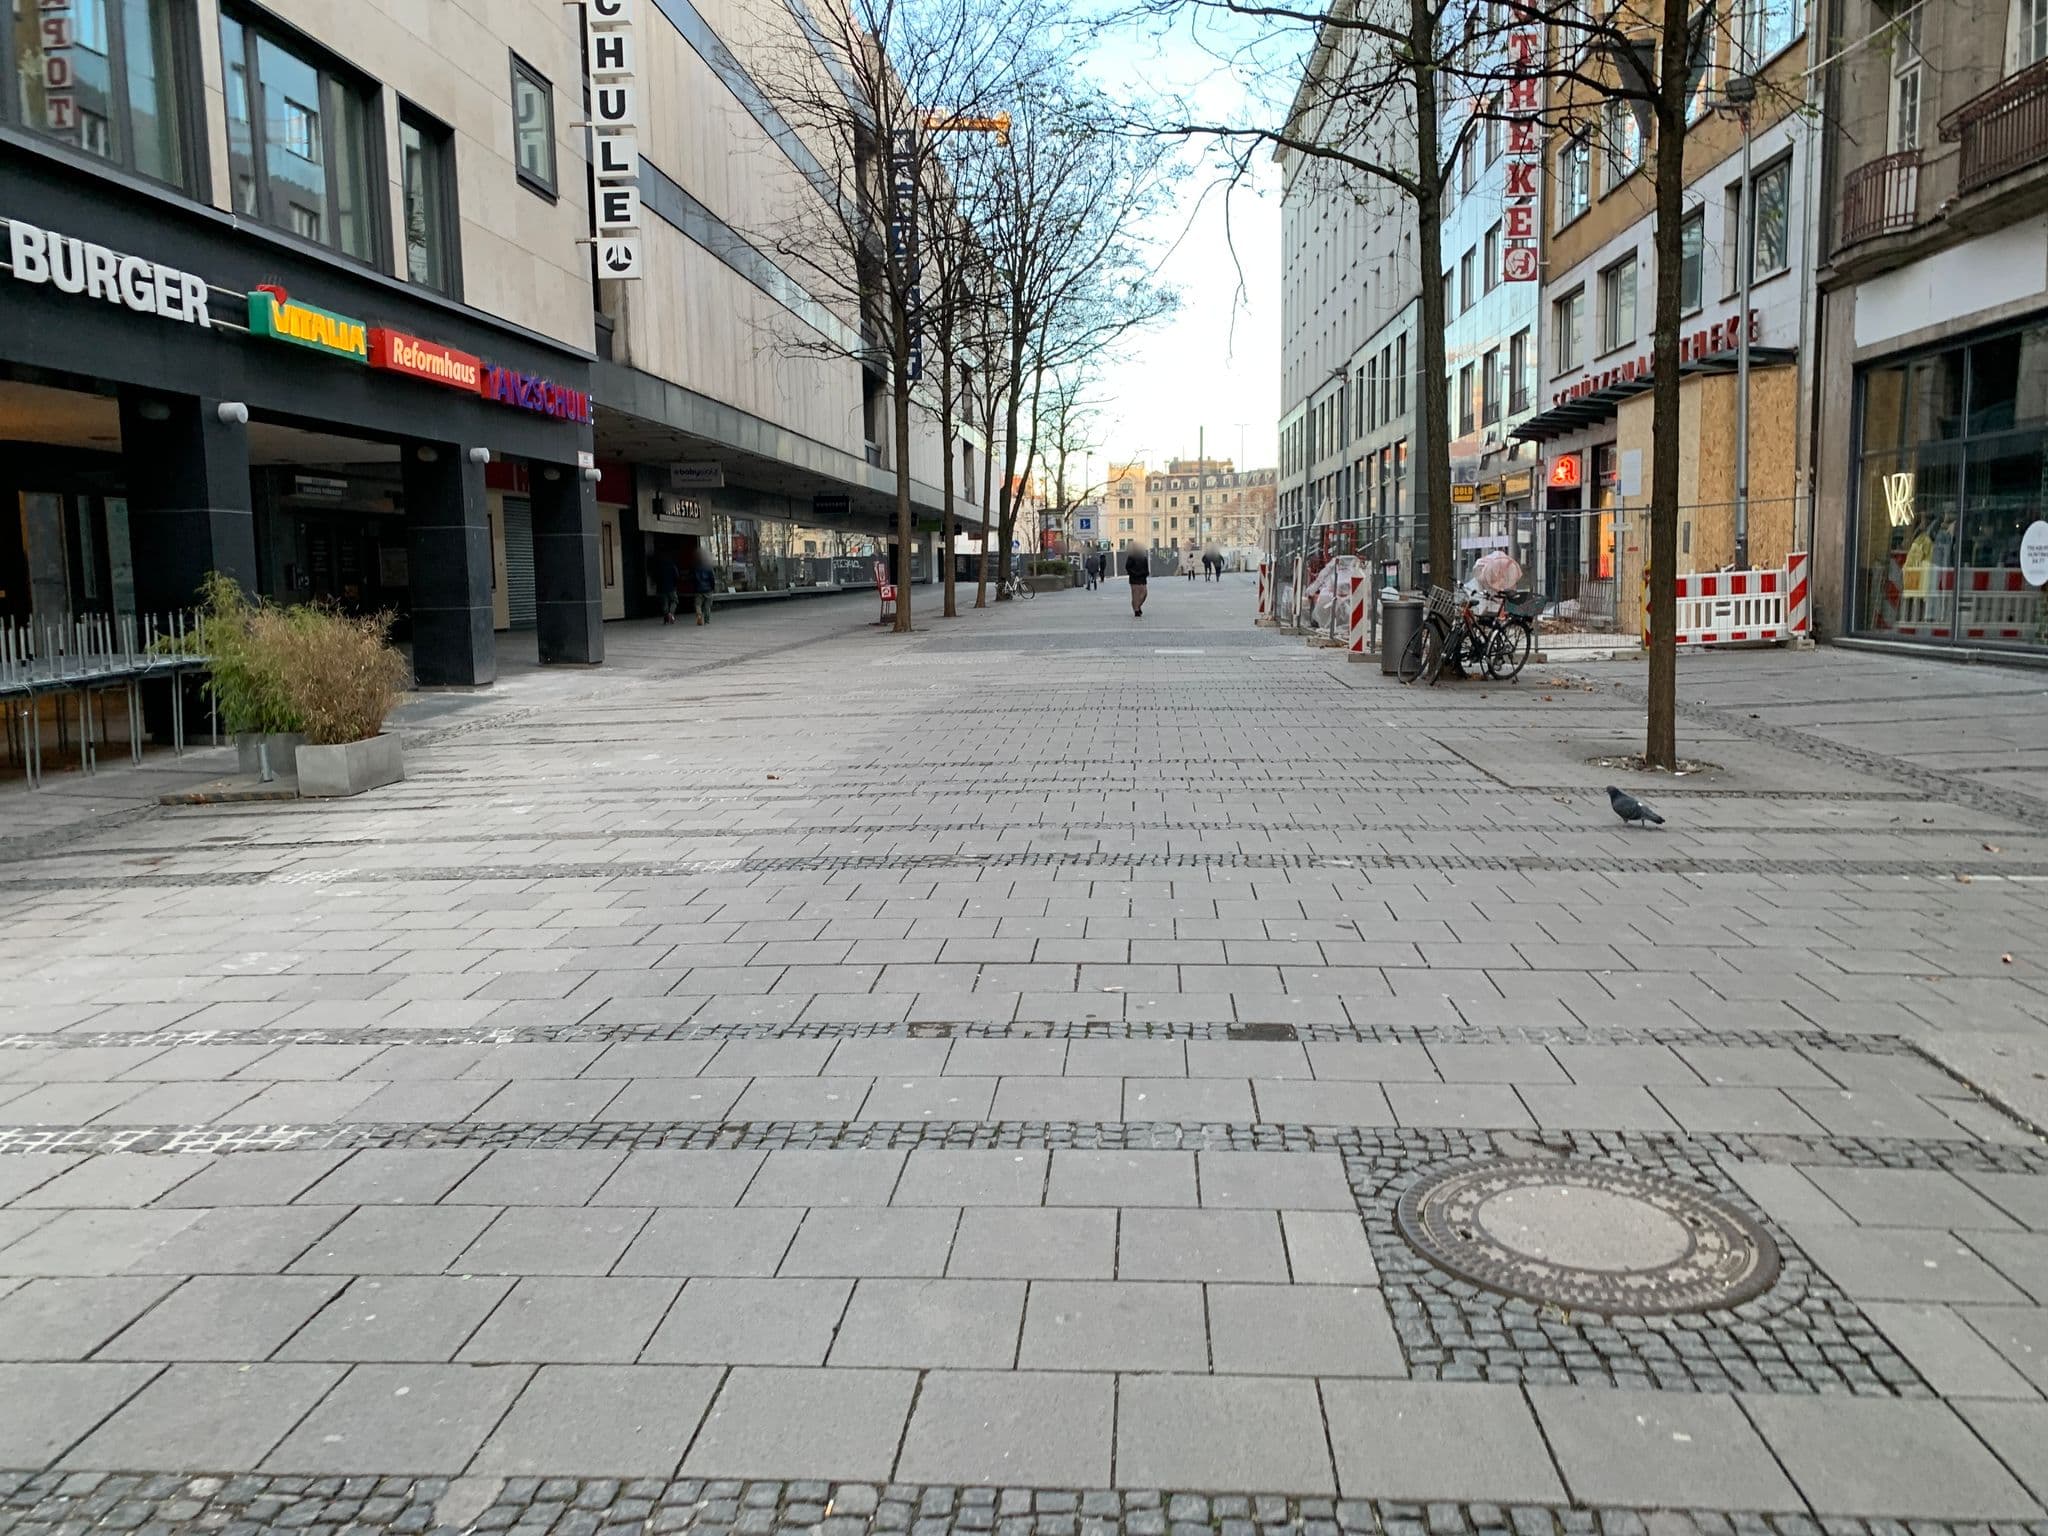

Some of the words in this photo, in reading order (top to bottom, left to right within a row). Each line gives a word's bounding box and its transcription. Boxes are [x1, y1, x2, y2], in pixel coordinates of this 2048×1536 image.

[9, 219, 211, 328] BURGER
[272, 299, 366, 355] VITALIA
[1553, 309, 1759, 406] SCHÜTZENATHEKE
[393, 336, 475, 385] Reformhaus
[487, 363, 594, 425] TANZSCHULE
